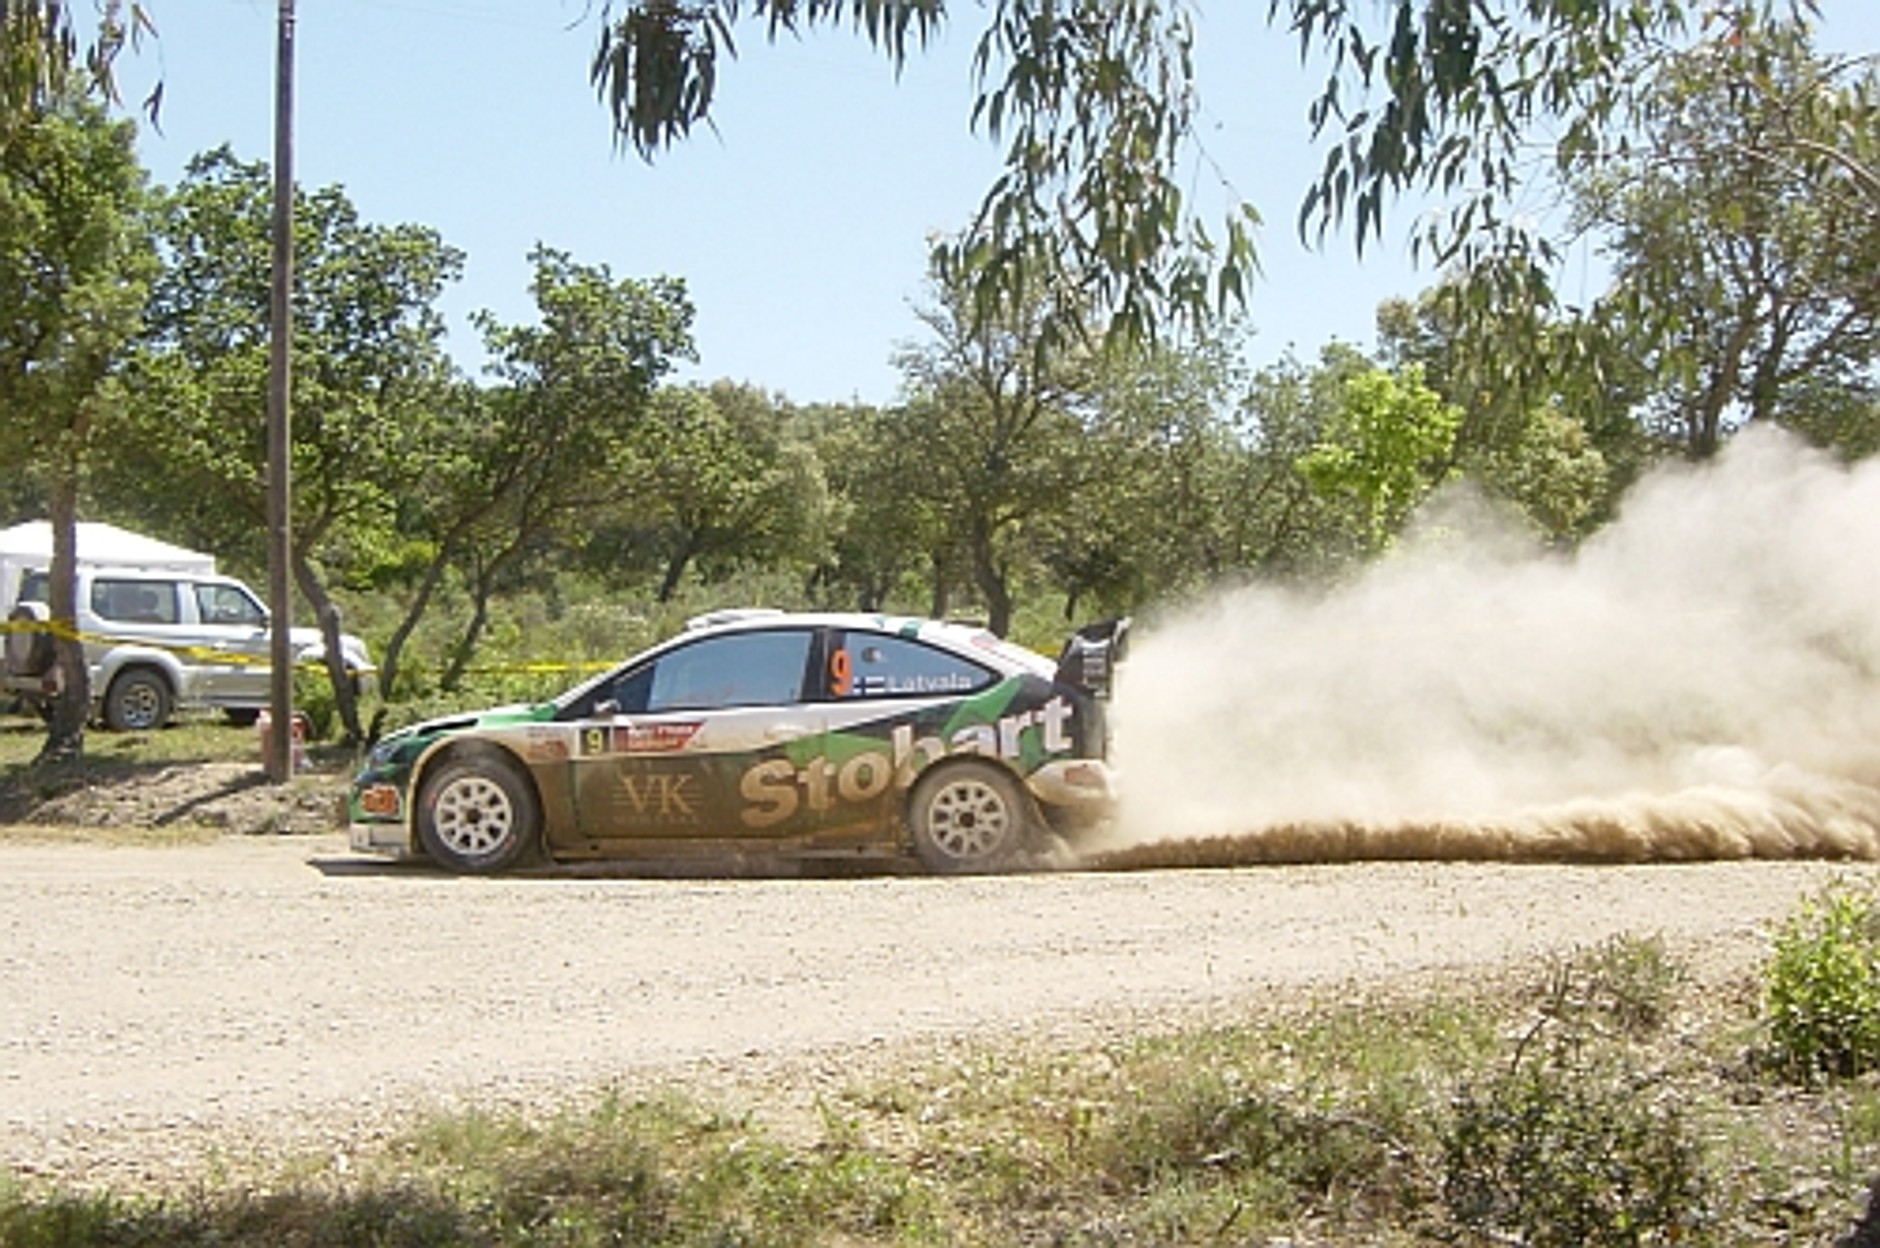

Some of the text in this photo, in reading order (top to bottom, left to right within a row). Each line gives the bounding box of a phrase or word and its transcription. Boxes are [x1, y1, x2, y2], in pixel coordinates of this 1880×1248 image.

[830, 649, 852, 697] 9
[886, 673, 972, 692] Latvala
[586, 728, 602, 754] 9
[740, 695, 1073, 828] Stobart
[616, 774, 693, 814] VK
